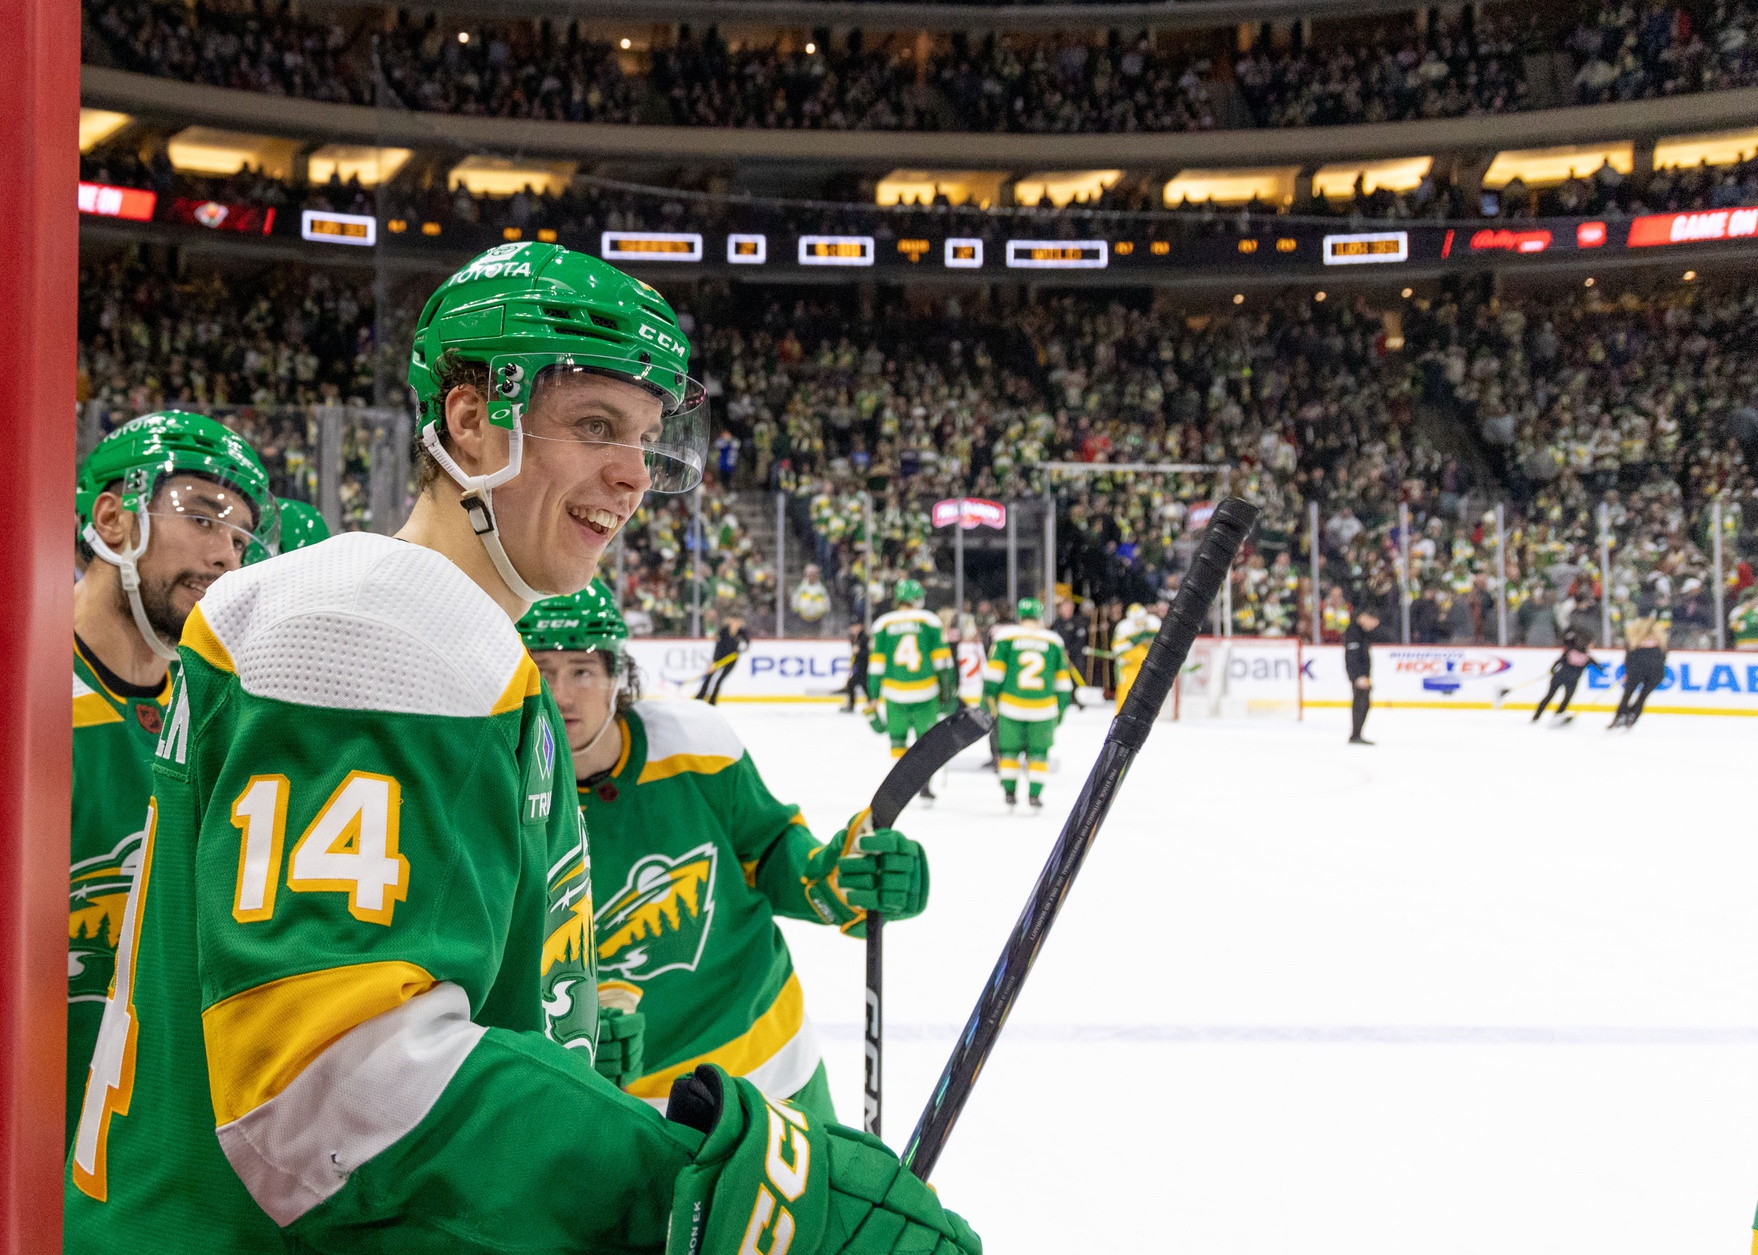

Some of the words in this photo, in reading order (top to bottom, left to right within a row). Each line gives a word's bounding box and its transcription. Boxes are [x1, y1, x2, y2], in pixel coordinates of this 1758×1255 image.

[1670, 212, 1728, 242] GAME
[447, 261, 531, 286] TOYOTA
[638, 323, 686, 358] CCM
[536, 620, 579, 629] CCM
[893, 634, 921, 672] 4
[1396, 660, 1491, 673] HOCEY
[1017, 651, 1045, 690] 2
[1108, 768, 1117, 780] PRO
[231, 770, 411, 927] 14
[692, 1201, 702, 1222] EK
